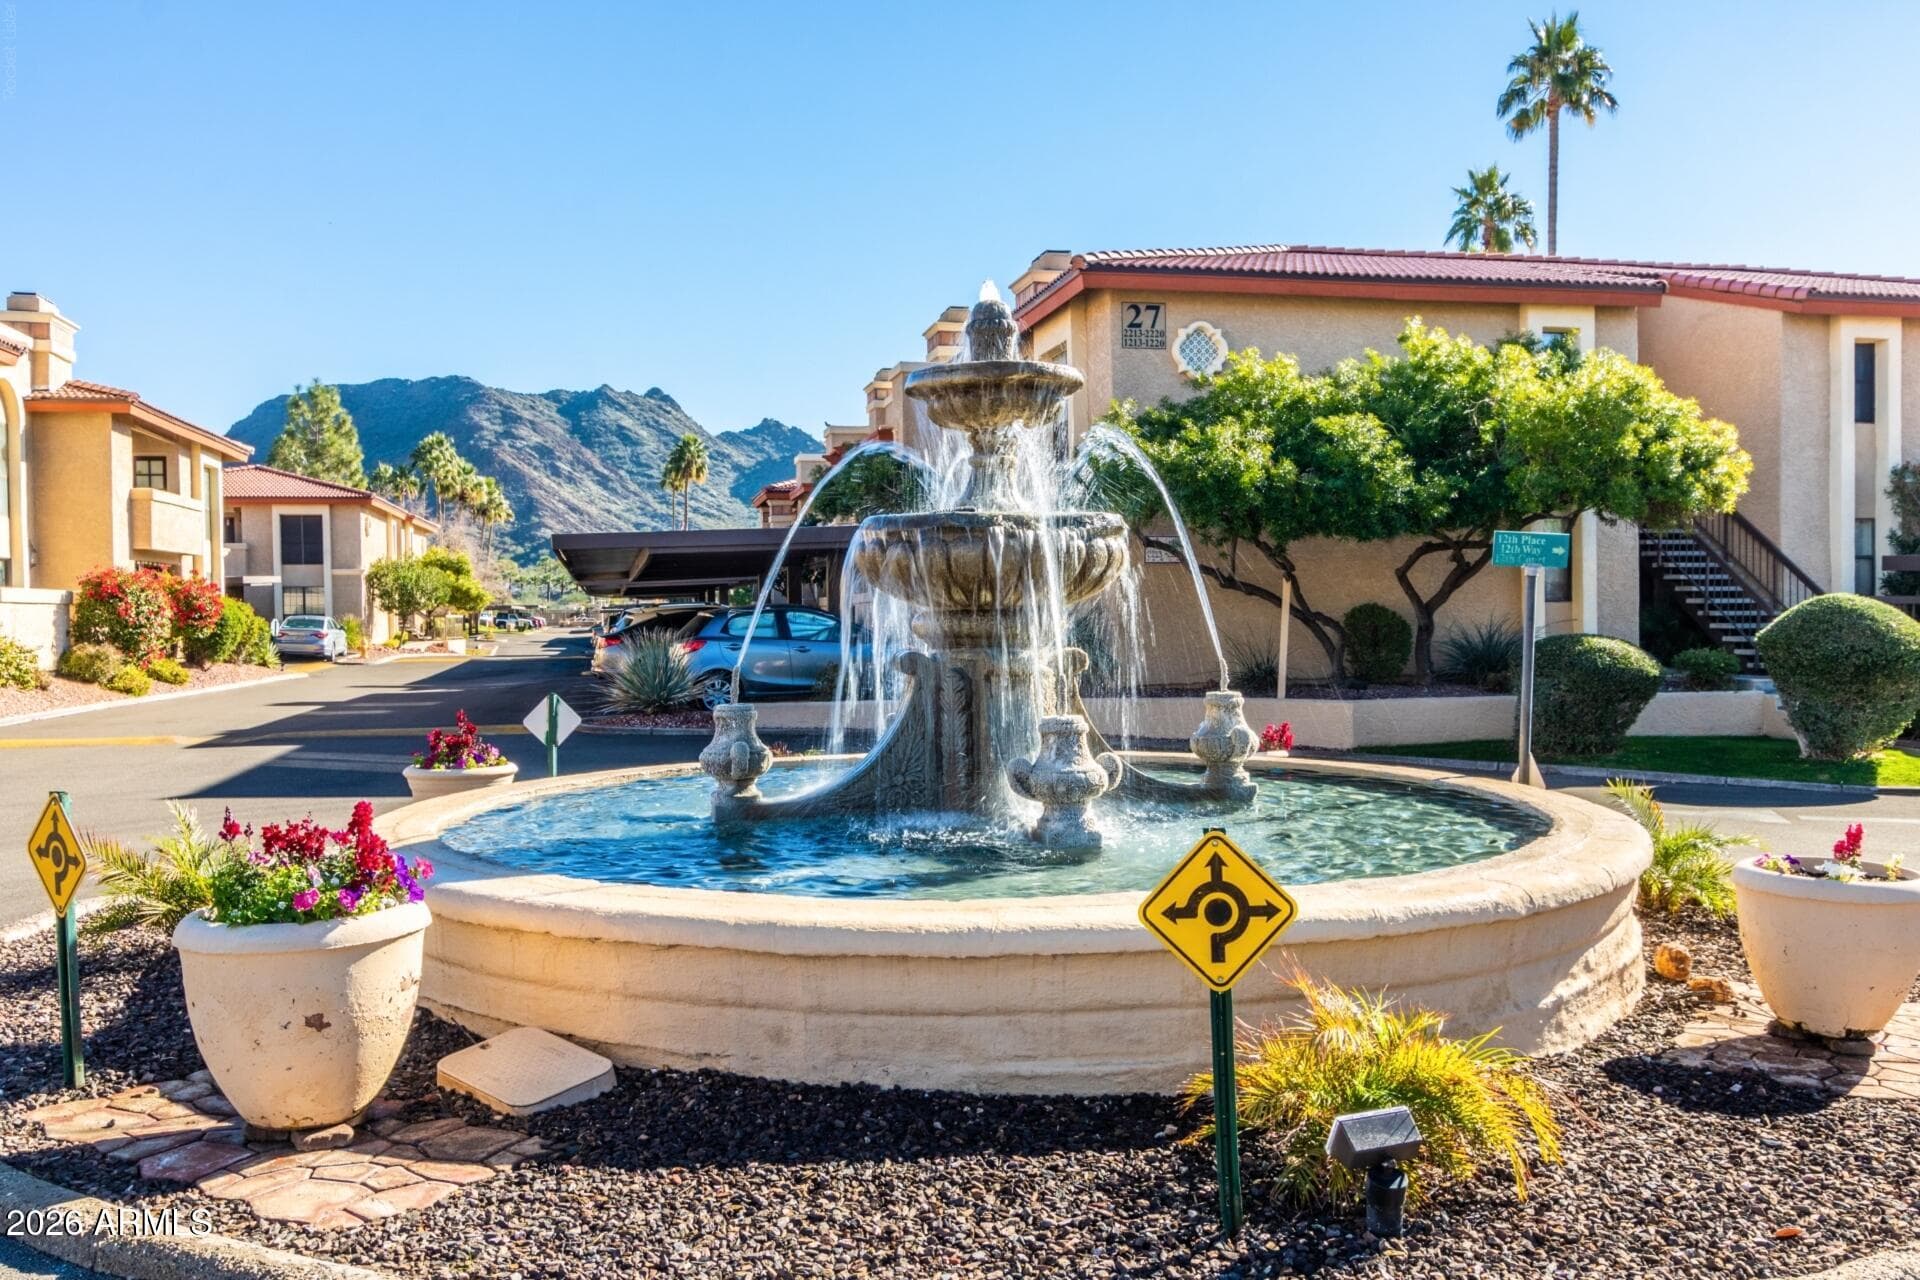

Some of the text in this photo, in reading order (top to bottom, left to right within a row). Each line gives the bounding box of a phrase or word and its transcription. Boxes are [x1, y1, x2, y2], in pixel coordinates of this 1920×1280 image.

[1126, 303, 1161, 329] 27
[1123, 328, 1165, 338] 2213-2220
[1123, 338, 1165, 348] 1213-1220
[1498, 534, 1547, 545] 12th Place
[1501, 544, 1541, 556] 12th Way
